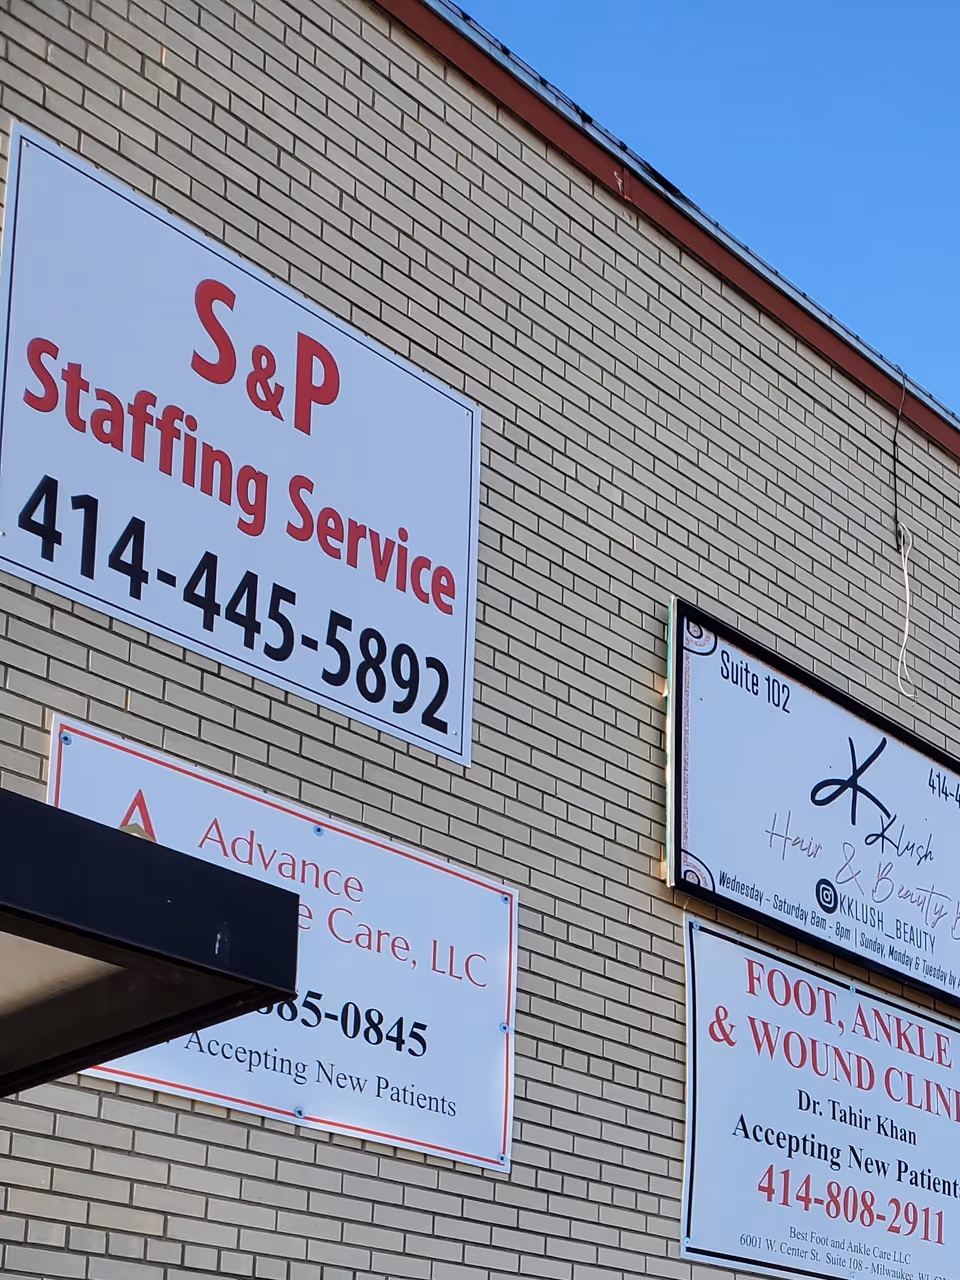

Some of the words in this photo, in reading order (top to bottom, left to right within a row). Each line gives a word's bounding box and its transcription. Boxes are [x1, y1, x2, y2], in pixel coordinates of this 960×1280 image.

[22, 337, 268, 538] Staffing
[285, 474, 457, 616] Service
[17, 475, 450, 735] 414-445-5892
[719, 650, 760, 696] Suite
[764, 674, 792, 714] 102
[198, 817, 365, 902] Advance
[764, 810, 823, 861] Hair
[835, 842, 865, 895] &
[872, 862, 951, 928] Beauty
[864, 814, 935, 866] Klush
[327, 906, 418, 970] Care,
[431, 939, 488, 988] LLC
[718, 869, 764, 907] Wednesday
[772, 894, 809, 925] Saturday
[809, 911, 827, 931] 8am
[834, 920, 851, 942] 8pm
[859, 931, 886, 959] Sunday,
[887, 944, 914, 970] Monday
[921, 958, 948, 985] Tuesday
[949, 970, 956, 987] by
[708, 1004, 738, 1048] &
[746, 1015, 876, 1092] WOUND
[743, 957, 846, 1037] FOOT,
[850, 1002, 954, 1069] ANKLE
[184, 1030, 307, 1085] Accepting
[315, 1059, 369, 1094] New
[375, 1074, 458, 1118] Patients
[732, 1113, 841, 1171] Accepting
[846, 1144, 890, 1178] New
[797, 1088, 823, 1116] Dr.
[827, 1097, 872, 1131] Tahir
[875, 1114, 918, 1146] Khan
[756, 1163, 946, 1246] 414-808-2911
[788, 1225, 809, 1242] Best
[810, 1231, 829, 1247] Foot
[830, 1238, 846, 1251] and
[846, 1240, 871, 1257] Ankle
[872, 1246, 892, 1261] Care
[892, 1250, 912, 1265] LLC
[739, 1232, 762, 1250] 6001
[765, 1238, 777, 1253] W.
[779, 1241, 809, 1260] Center
[809, 1248, 821, 1263] St.
[825, 1252, 847, 1269] Suite
[848, 1257, 864, 1272] 108
